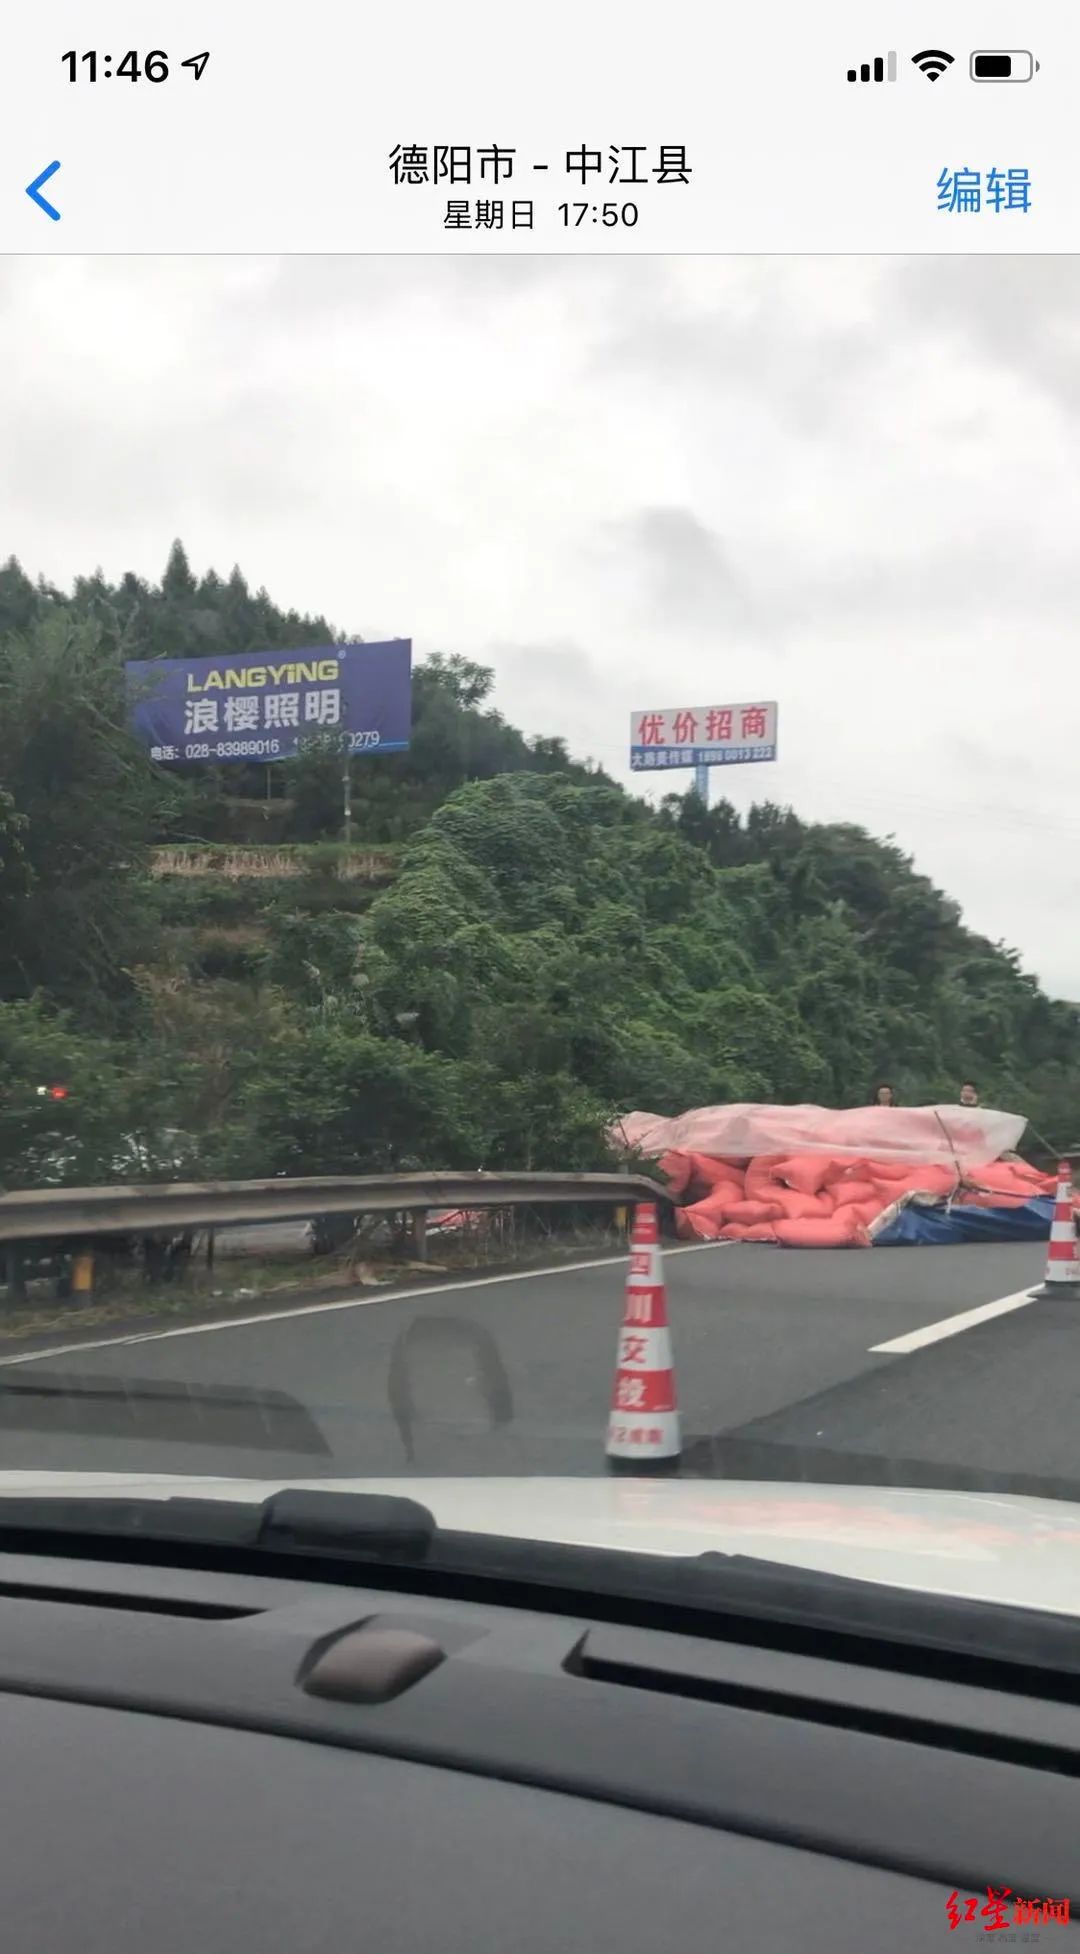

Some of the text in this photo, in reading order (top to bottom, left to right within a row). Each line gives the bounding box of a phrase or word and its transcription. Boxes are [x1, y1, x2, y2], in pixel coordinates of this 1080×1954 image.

[61, 50, 169, 84] 11:46
[388, 143, 517, 185] 德阳市
[565, 143, 693, 186] 中江县
[936, 166, 1032, 214] 编辑
[443, 199, 639, 230] 星期日 17:50
[184, 688, 340, 735] 浪樱照明
[638, 707, 768, 745] 优价招商
